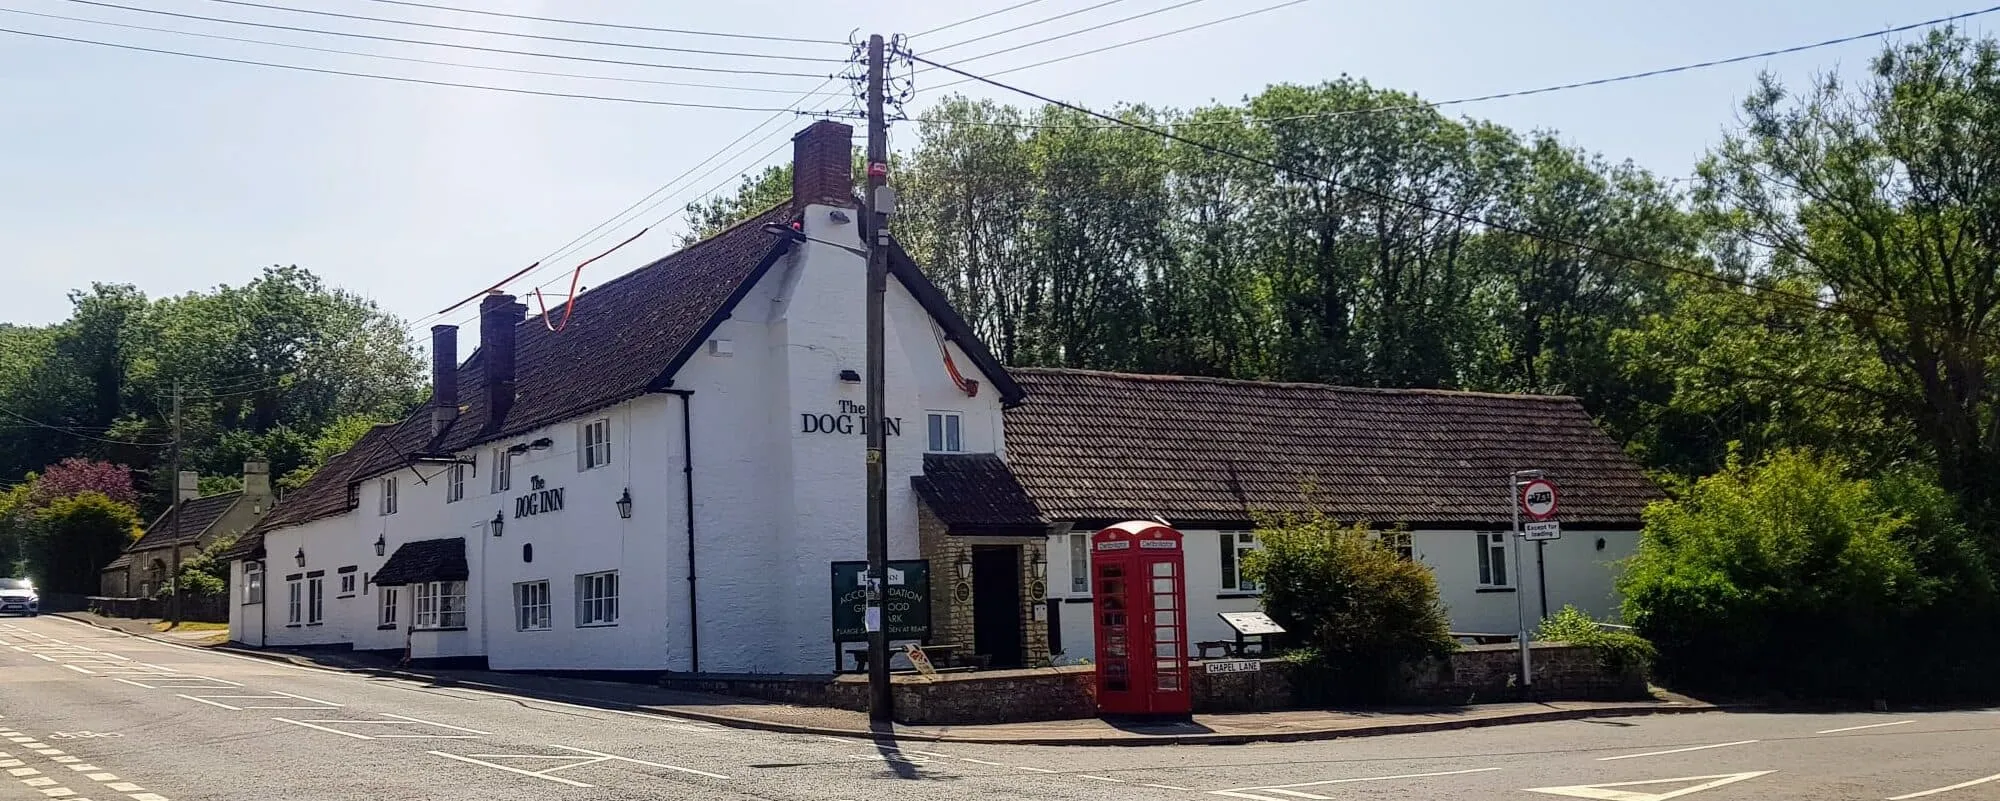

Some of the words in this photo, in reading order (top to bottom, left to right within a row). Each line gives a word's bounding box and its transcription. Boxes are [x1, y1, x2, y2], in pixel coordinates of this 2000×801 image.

[838, 399, 866, 414] The
[801, 413, 854, 436] DOG
[859, 416, 902, 437] IN
[531, 475, 545, 490] The
[515, 493, 537, 518] DOG
[540, 488, 564, 513] INN
[840, 588, 923, 604] ACCODATION
[887, 602, 910, 611] OOD
[1208, 662, 1236, 673] CHAPEL
[1238, 661, 1258, 671] LANE
